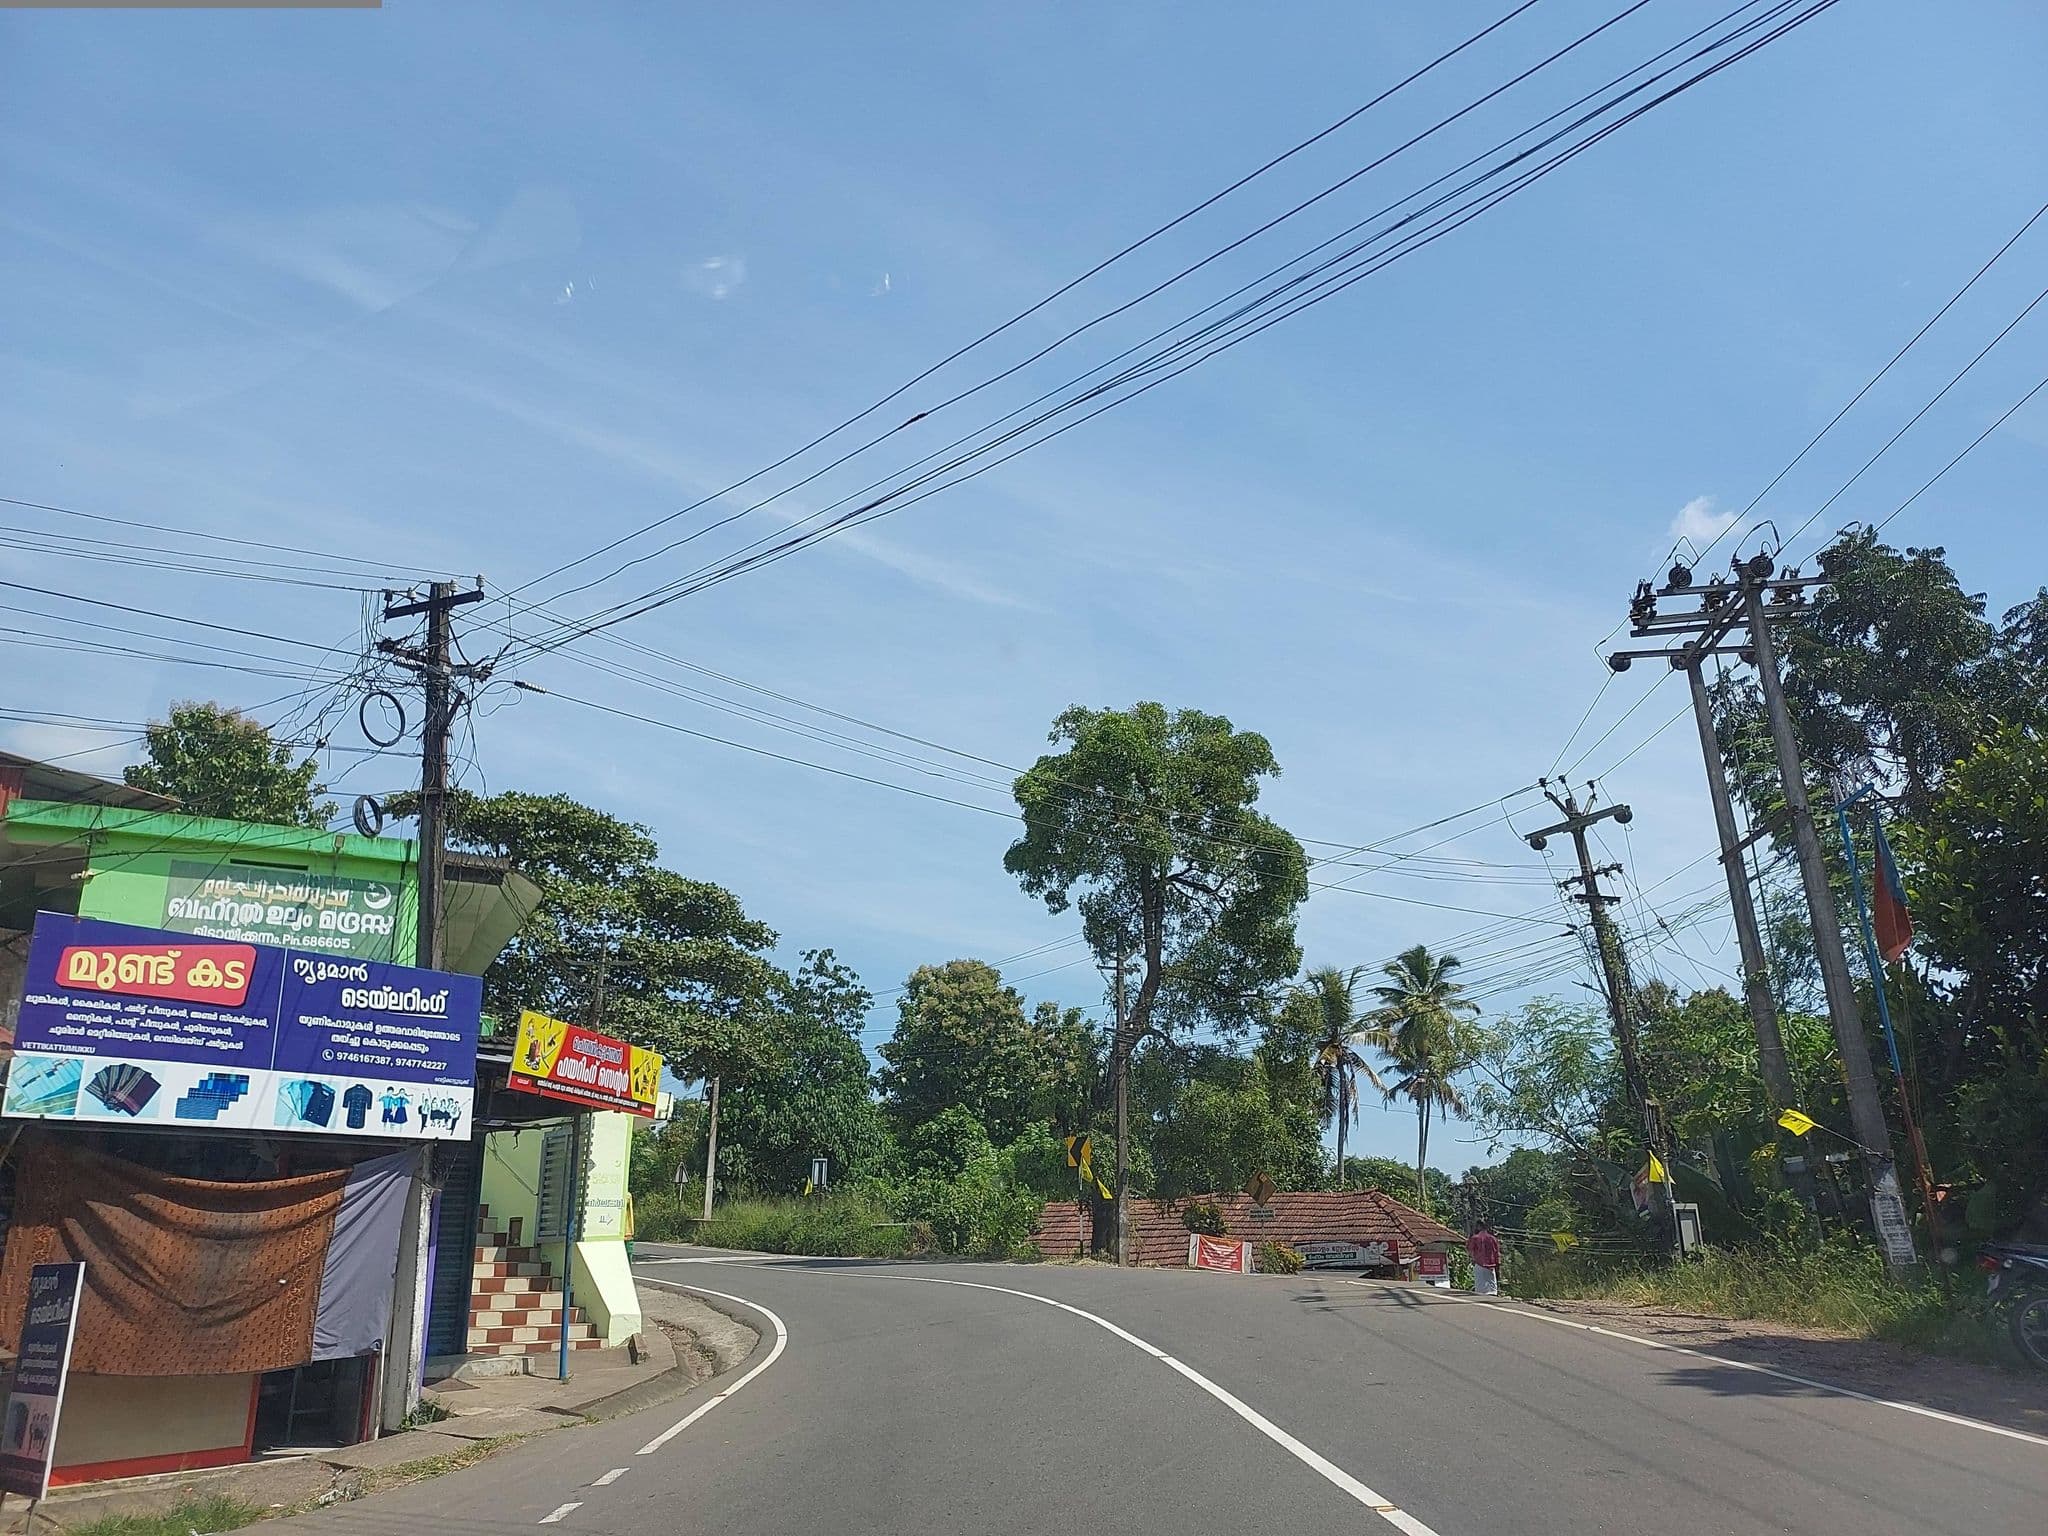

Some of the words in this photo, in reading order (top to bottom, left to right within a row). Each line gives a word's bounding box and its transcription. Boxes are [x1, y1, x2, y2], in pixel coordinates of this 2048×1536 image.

[68, 950, 181, 990] മുണ്ട്
[187, 959, 246, 990] കട
[294, 958, 369, 984] ന്യൂമാൻ
[336, 1051, 394, 1067] 9746167387,
[395, 1058, 447, 1071] 9747742227
